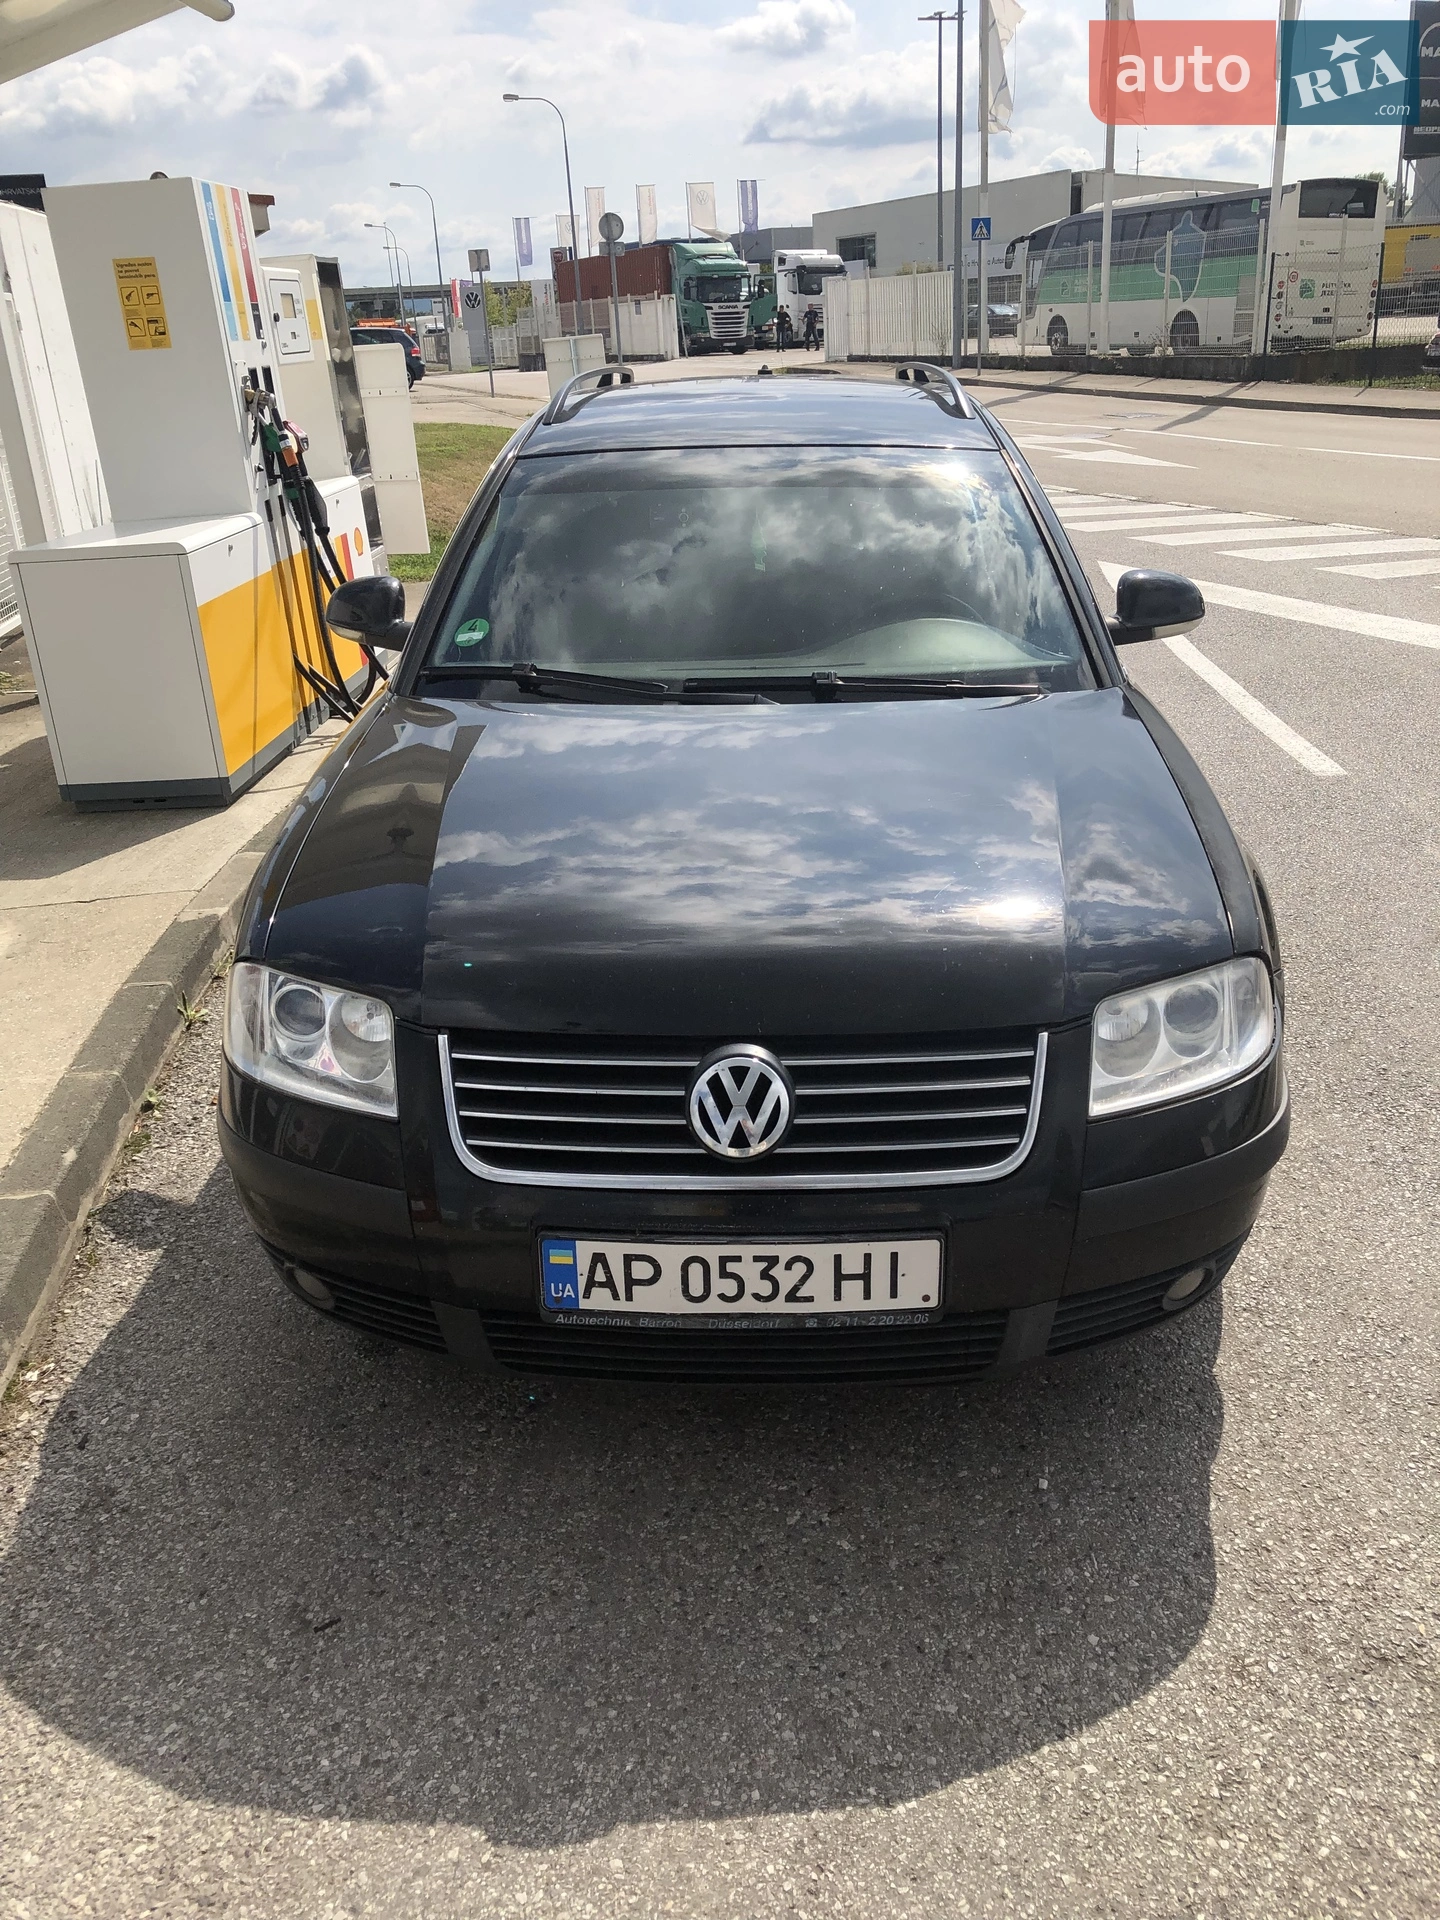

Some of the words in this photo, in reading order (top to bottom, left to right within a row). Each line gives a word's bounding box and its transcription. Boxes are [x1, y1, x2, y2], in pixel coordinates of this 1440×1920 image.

[1421, 99, 1440, 107] MA
[582, 1252, 662, 1302] AP
[680, 1255, 814, 1304] 0532
[833, 1251, 899, 1301] HI
[551, 1282, 575, 1299] UA
